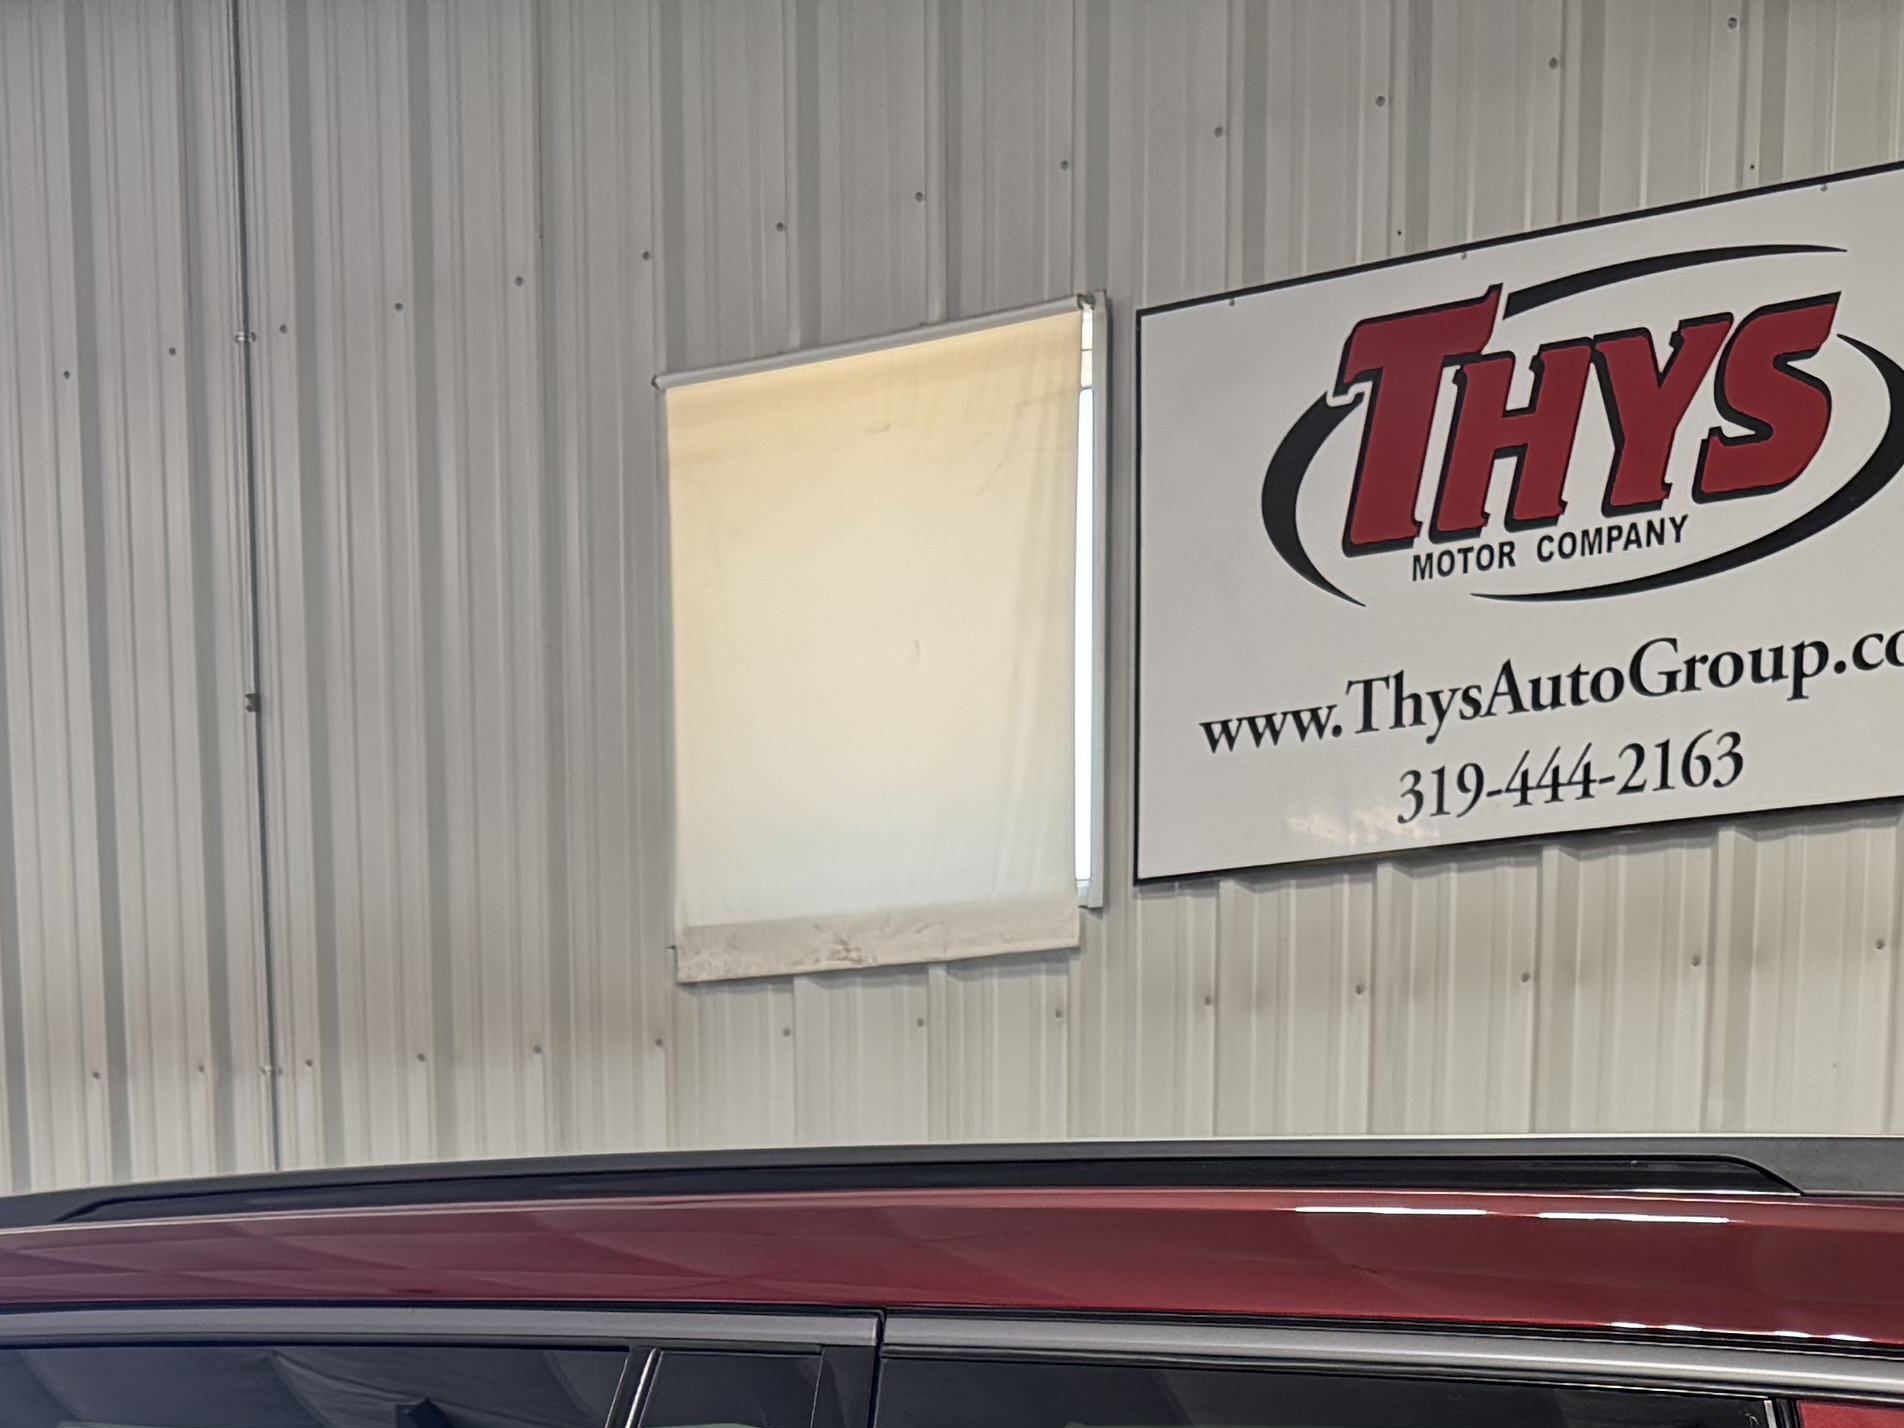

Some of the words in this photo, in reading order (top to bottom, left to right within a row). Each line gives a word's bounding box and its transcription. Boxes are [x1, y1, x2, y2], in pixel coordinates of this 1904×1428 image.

[1332, 282, 1842, 557] THYS
[1412, 540, 1517, 582] MOTOR
[1536, 514, 1690, 563] COMPANY
[1397, 731, 1745, 825] 319-444-2163
